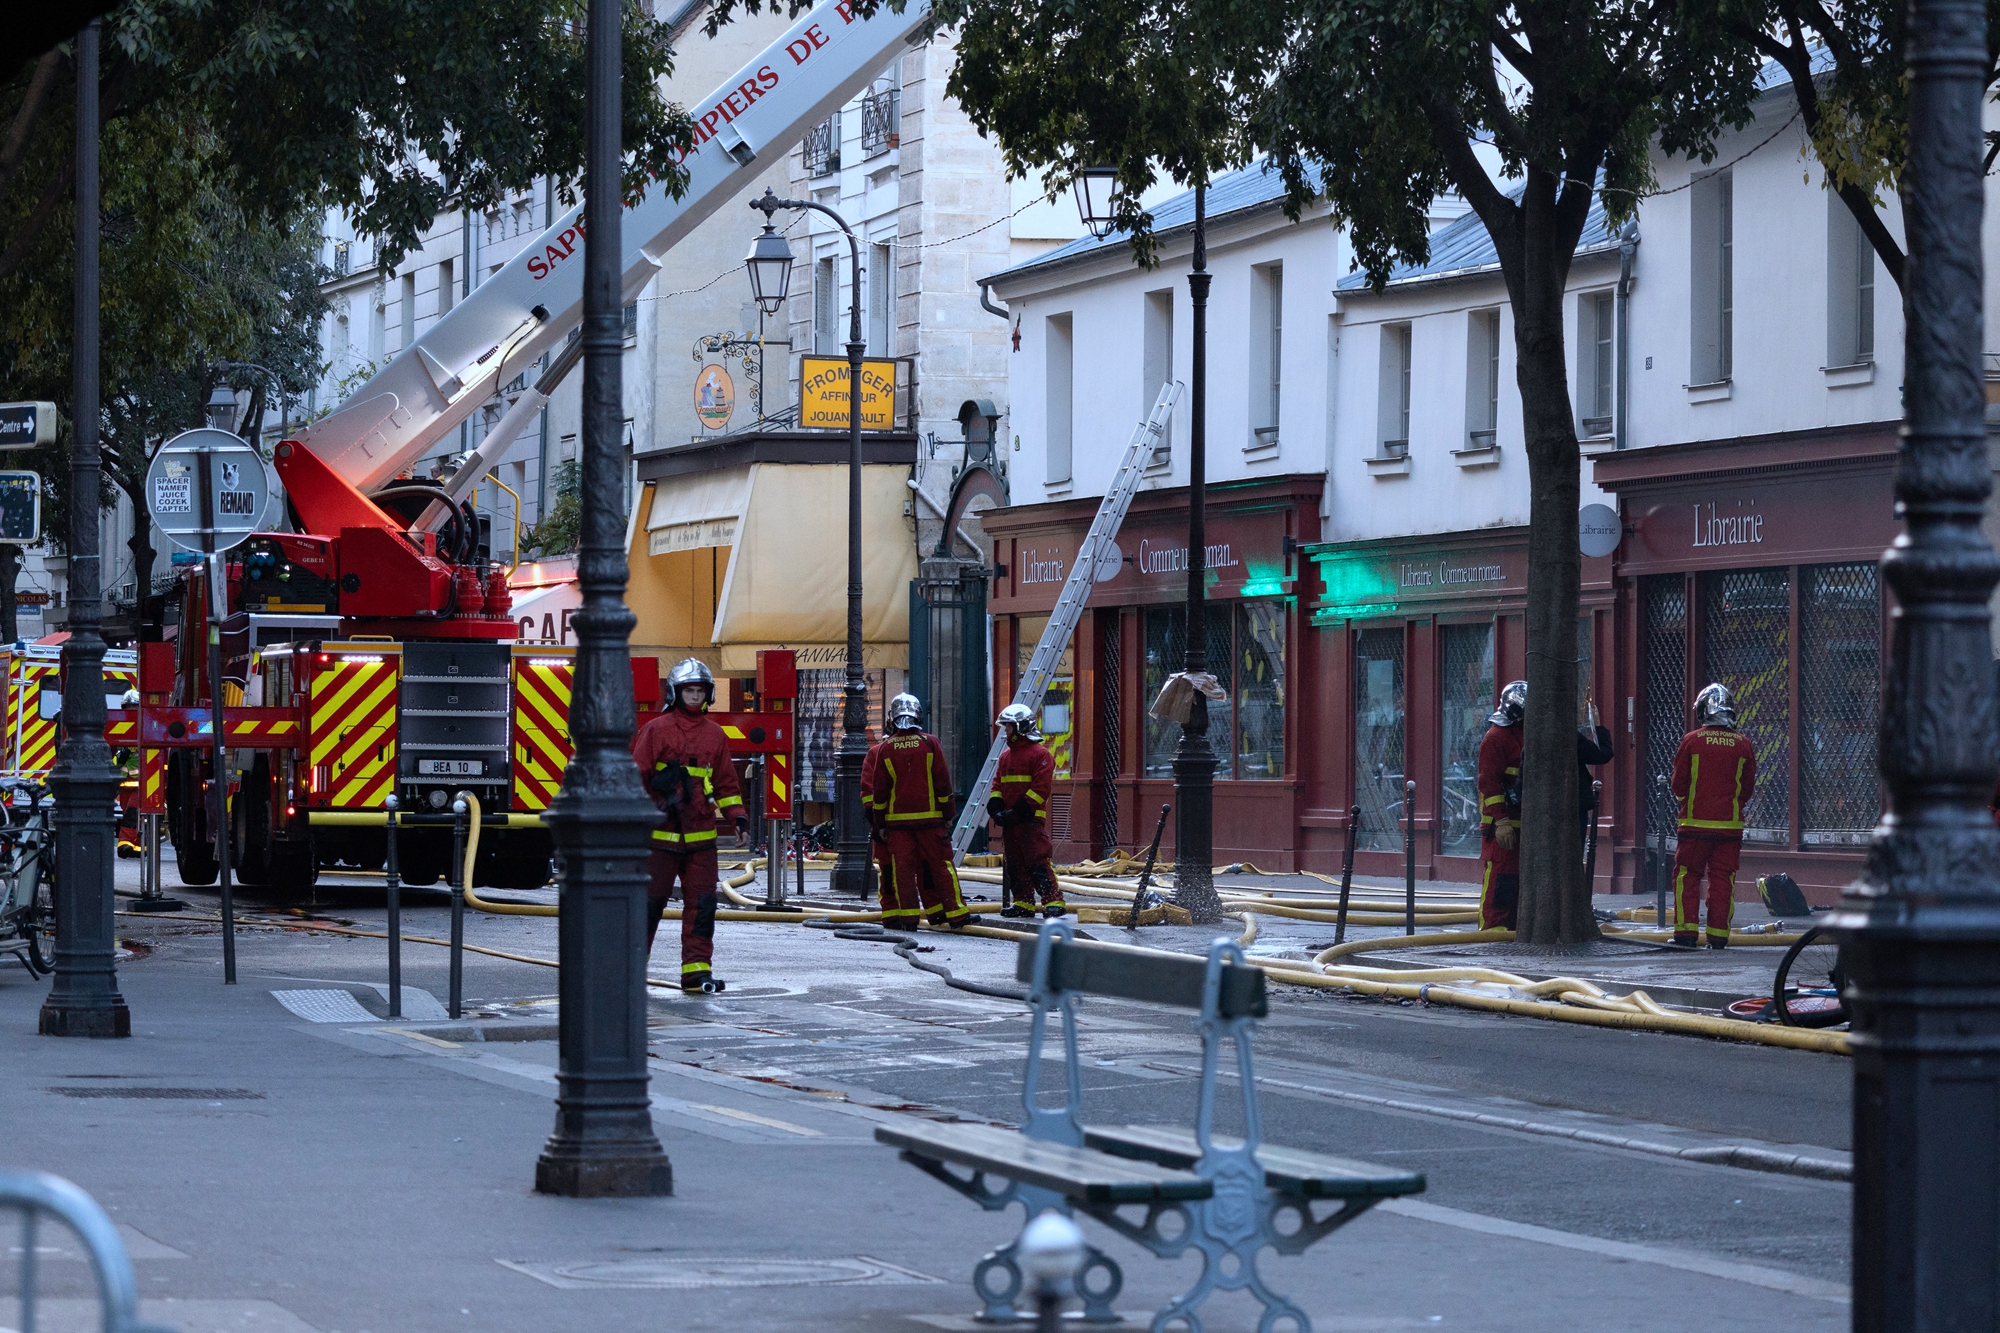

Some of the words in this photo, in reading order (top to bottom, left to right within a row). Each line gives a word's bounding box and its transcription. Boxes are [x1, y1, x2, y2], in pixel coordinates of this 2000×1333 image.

[785, 23, 830, 66] DE
[804, 366, 893, 398] FROMGER
[820, 391, 877, 403] AFFINUR
[809, 411, 886, 423] JOUANAULT
[220, 492, 254, 514] REMAND
[1693, 498, 1764, 546] Librairie
[1022, 547, 1064, 584] Librairie
[1140, 538, 1180, 574] Comme
[1401, 563, 1433, 587] Librairie
[1440, 560, 1467, 584] Comme
[894, 740, 920, 749] PARIS
[1706, 737, 1735, 747] PARIS
[433, 761, 451, 773] BEA
[458, 762, 468, 772] 10
